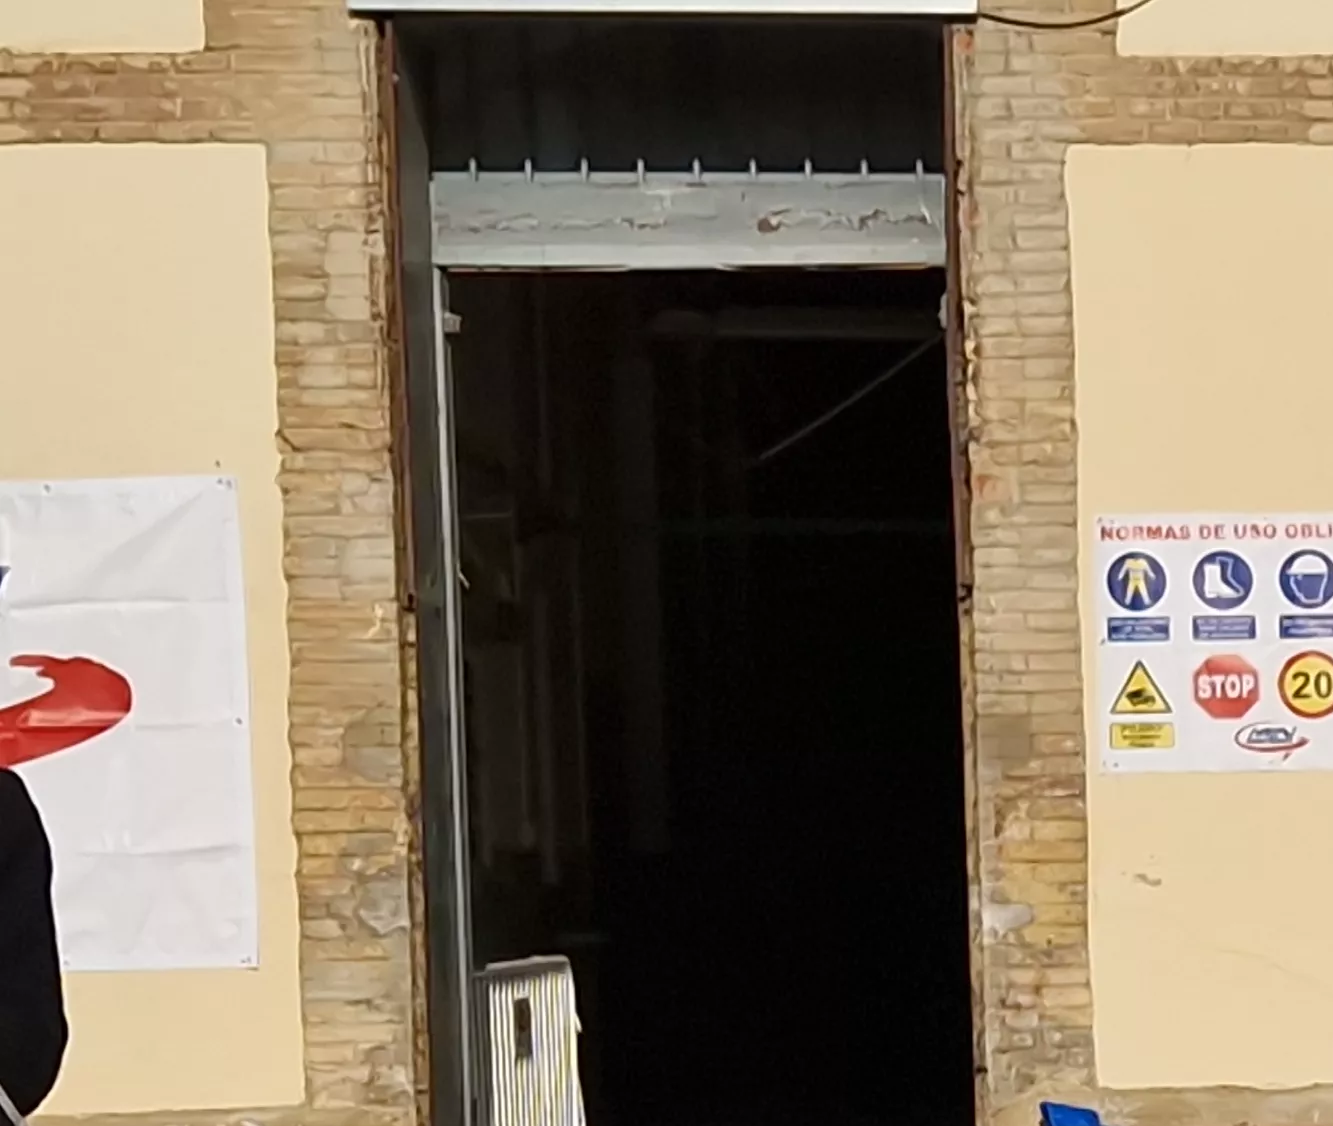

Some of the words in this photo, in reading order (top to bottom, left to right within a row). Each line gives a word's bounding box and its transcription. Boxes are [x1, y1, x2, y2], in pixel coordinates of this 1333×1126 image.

[1100, 524, 1191, 541] NORMAS
[1199, 524, 1226, 540] DE
[1233, 523, 1277, 540] USO
[1197, 673, 1255, 699] STOP
[1291, 671, 1333, 700] 20
